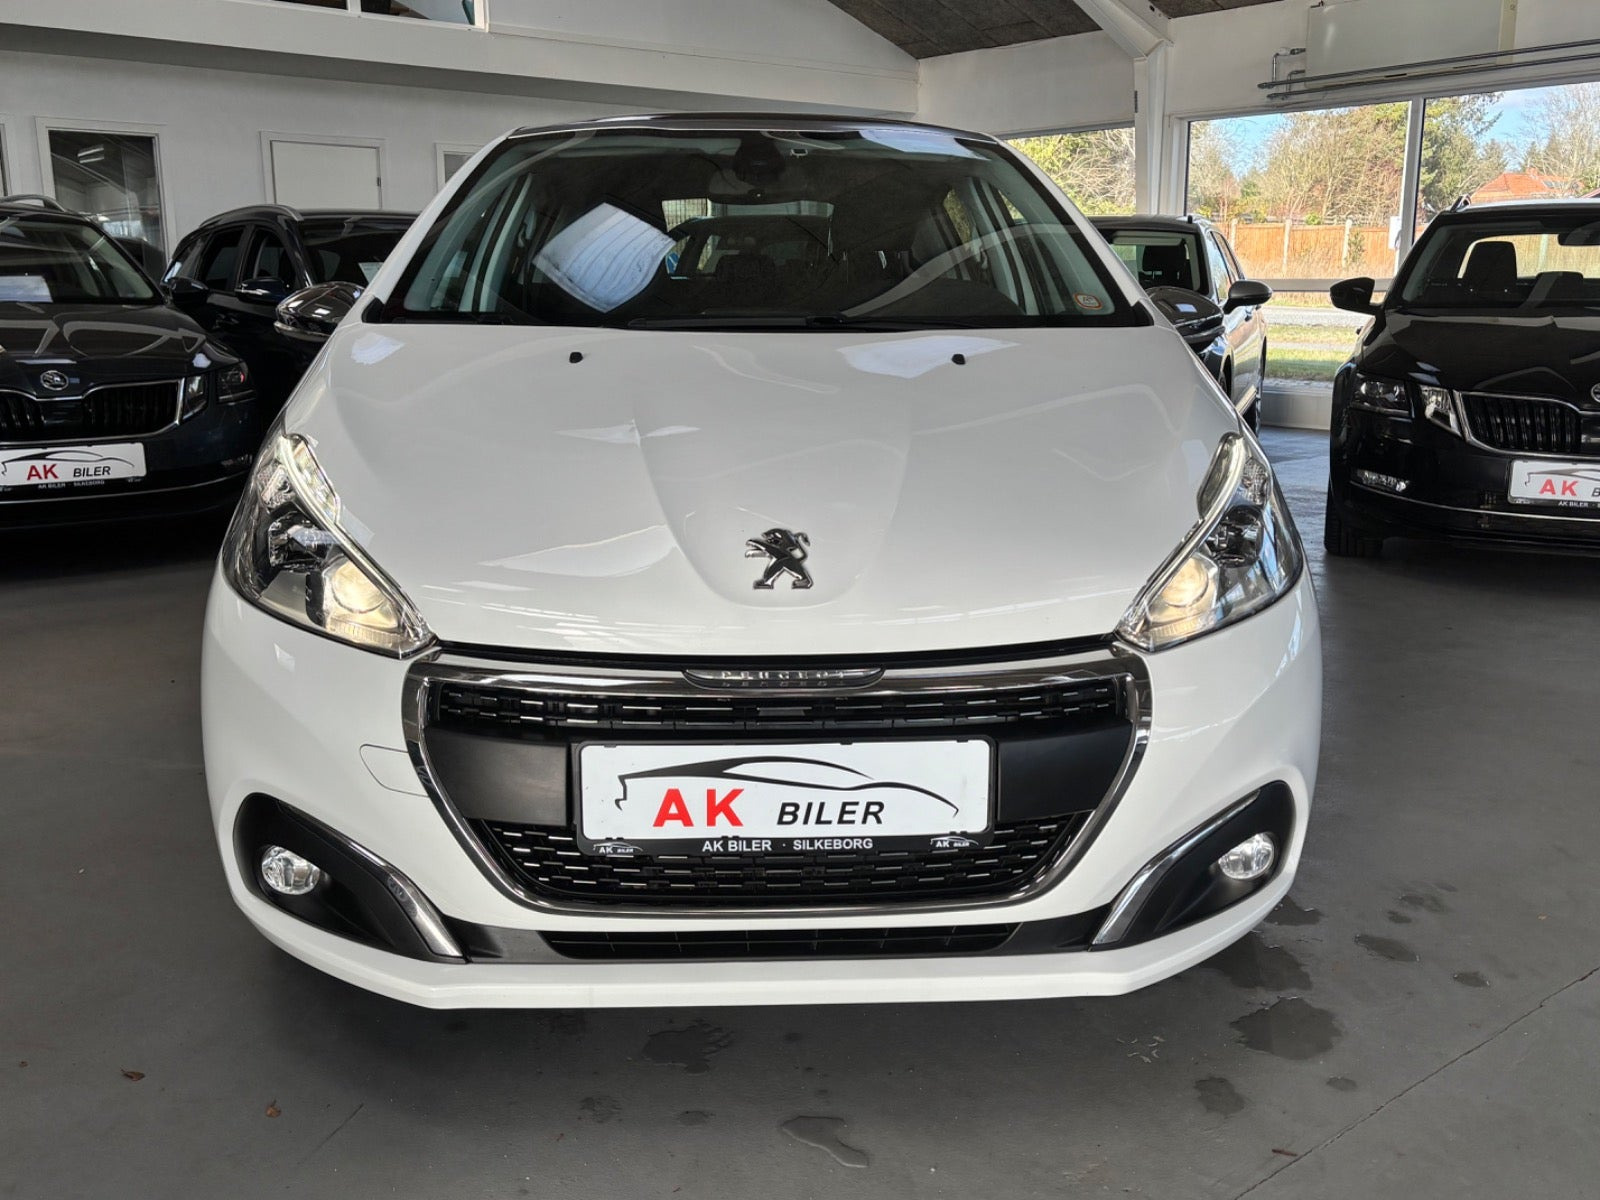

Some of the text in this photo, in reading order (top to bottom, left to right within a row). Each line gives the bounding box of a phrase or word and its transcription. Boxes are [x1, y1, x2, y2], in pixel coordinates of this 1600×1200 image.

[27, 464, 111, 481] AK BILER
[1539, 479, 1578, 497] AK
[653, 788, 885, 828] AK BILER
[599, 846, 613, 854] AK
[702, 838, 873, 852] AK BILER SILKEBORG
[935, 840, 950, 848] AK
